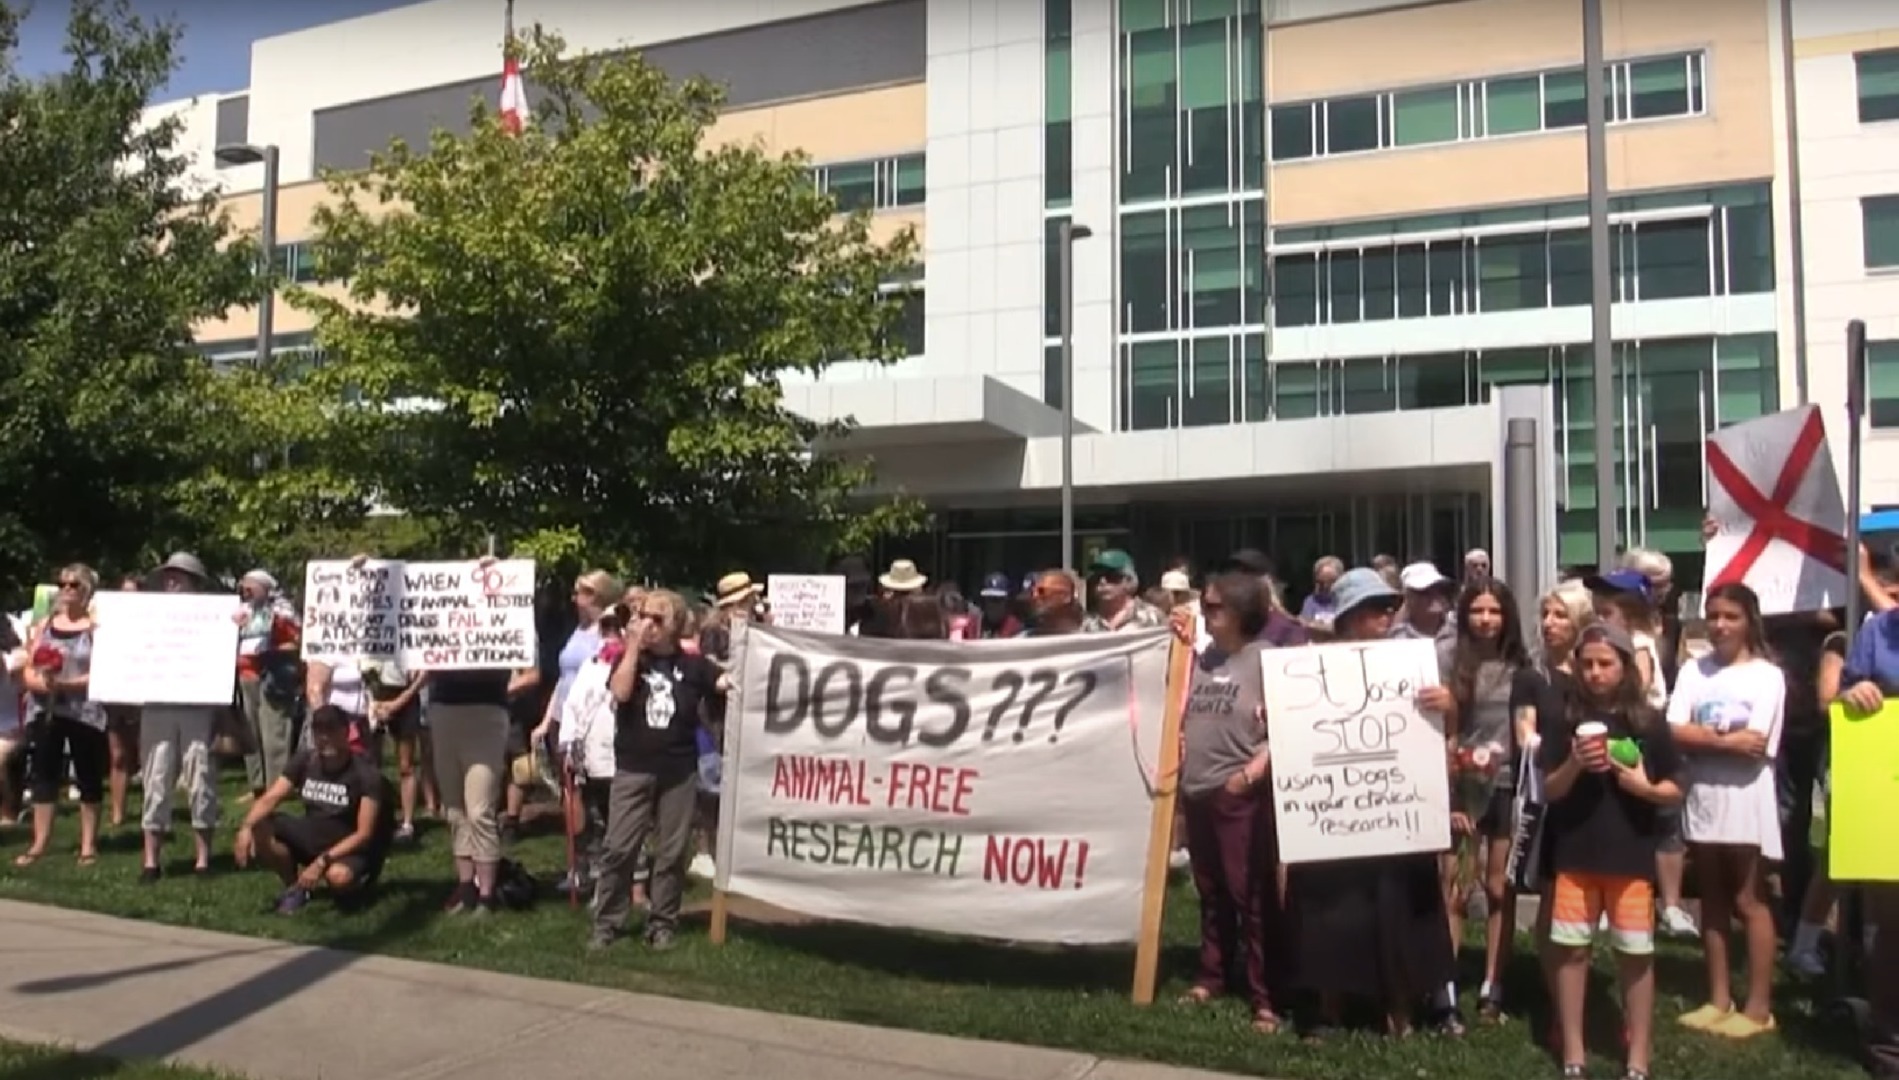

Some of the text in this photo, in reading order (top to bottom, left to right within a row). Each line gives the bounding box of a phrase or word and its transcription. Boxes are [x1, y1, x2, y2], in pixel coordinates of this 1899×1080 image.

[404, 572, 461, 592] WHEN
[306, 606, 317, 628] 3
[400, 597, 418, 611] OF
[398, 611, 507, 629] DRUGS FAIL IN
[465, 629, 525, 646] CHANGE
[465, 648, 529, 663] OPTIONAL
[1283, 654, 1345, 711] St
[764, 653, 972, 747] DOGS
[1312, 712, 1407, 754] STOP
[771, 755, 980, 816] ANIMAL-FREE
[1276, 766, 1406, 800] using Dogs
[1283, 801, 1300, 813] in
[1304, 796, 1349, 826] your
[767, 816, 962, 877] RESEARCH
